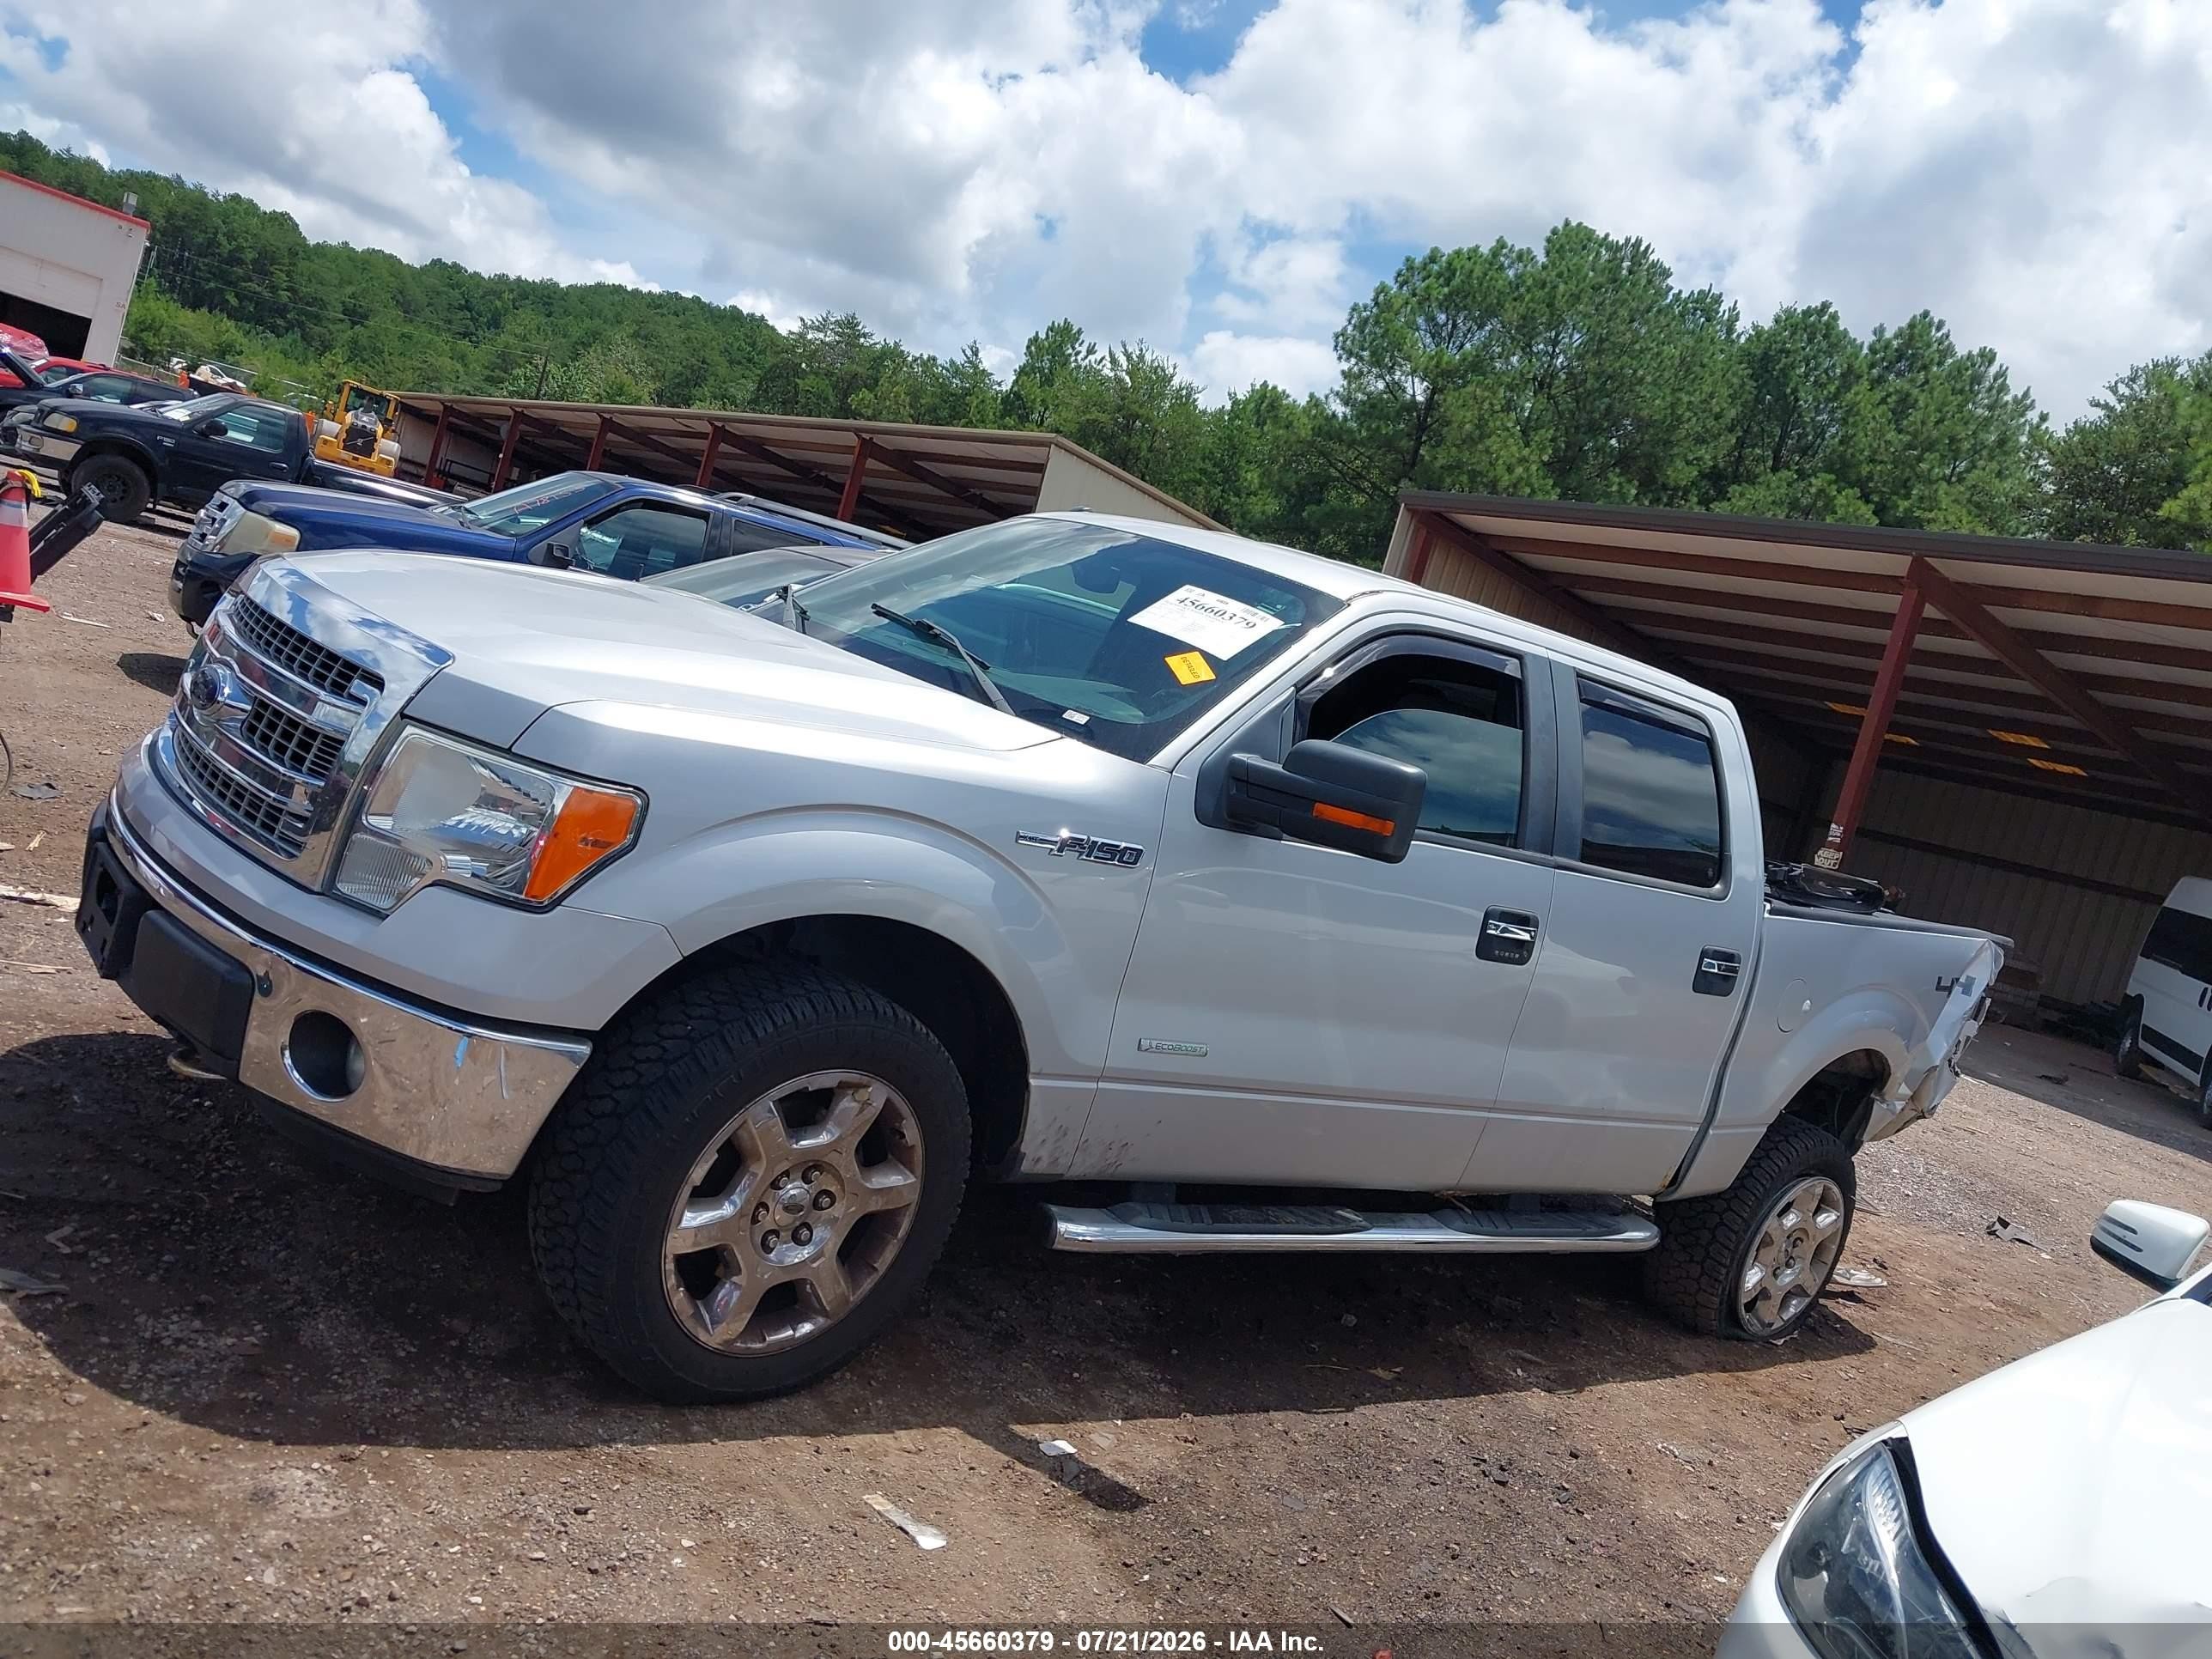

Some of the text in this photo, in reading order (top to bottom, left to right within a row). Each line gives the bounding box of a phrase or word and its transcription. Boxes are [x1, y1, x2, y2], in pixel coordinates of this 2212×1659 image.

[1176, 597, 1257, 629] 45660379
[1180, 656, 1200, 679] DETAILED
[1817, 849, 1840, 860] KEEP
[1819, 857, 1838, 866] OUT
[1155, 1042, 1205, 1054] ECOBOOST
